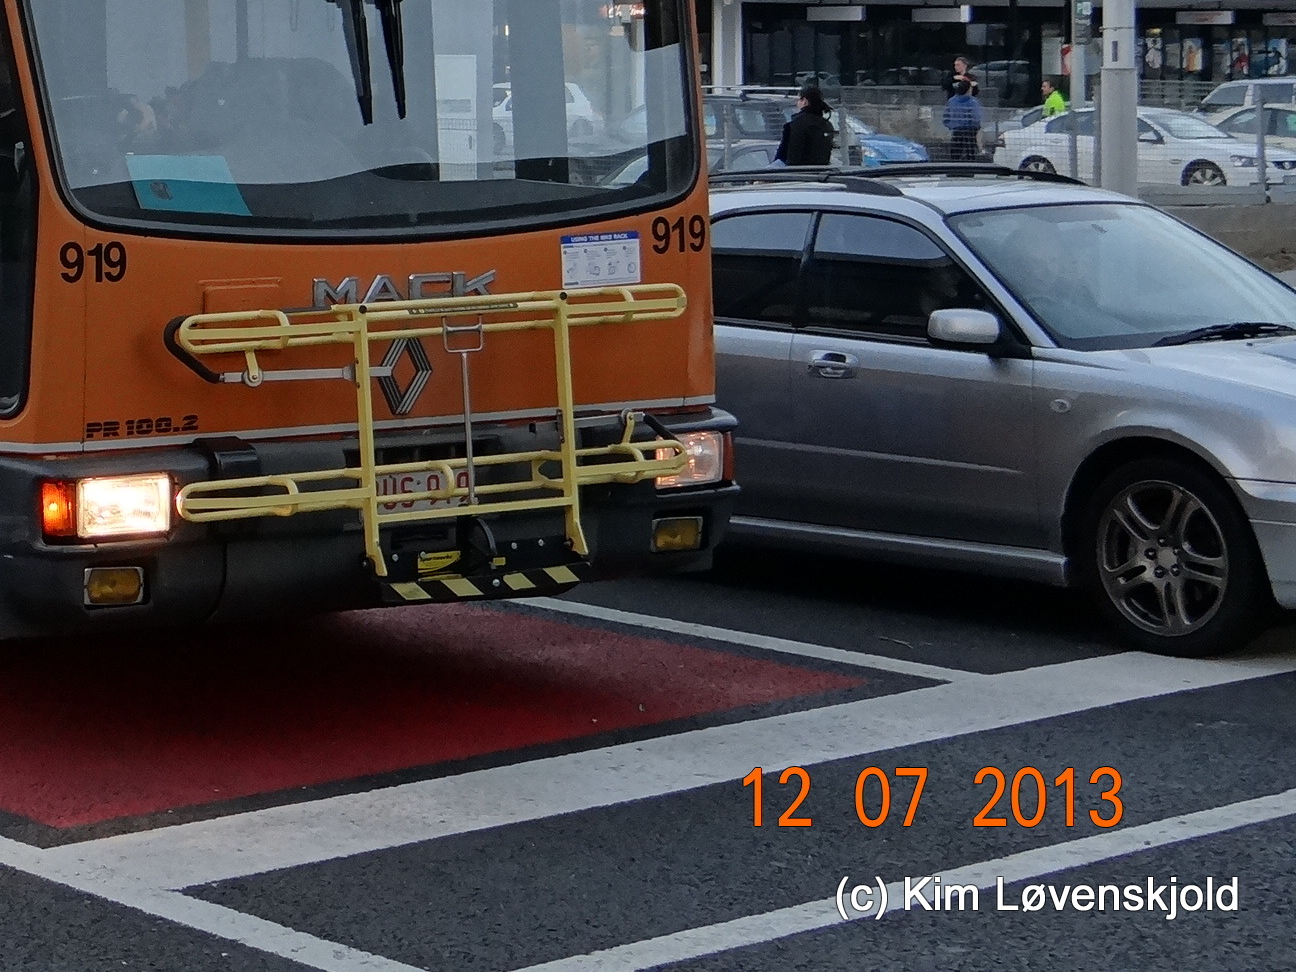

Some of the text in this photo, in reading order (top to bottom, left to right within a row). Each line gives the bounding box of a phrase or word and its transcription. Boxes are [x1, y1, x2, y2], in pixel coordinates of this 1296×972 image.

[651, 214, 705, 254] 919
[59, 240, 127, 284] 919
[312, 269, 497, 311] MACK
[86, 414, 199, 438] PR 100.2
[375, 471, 471, 510] US 99
